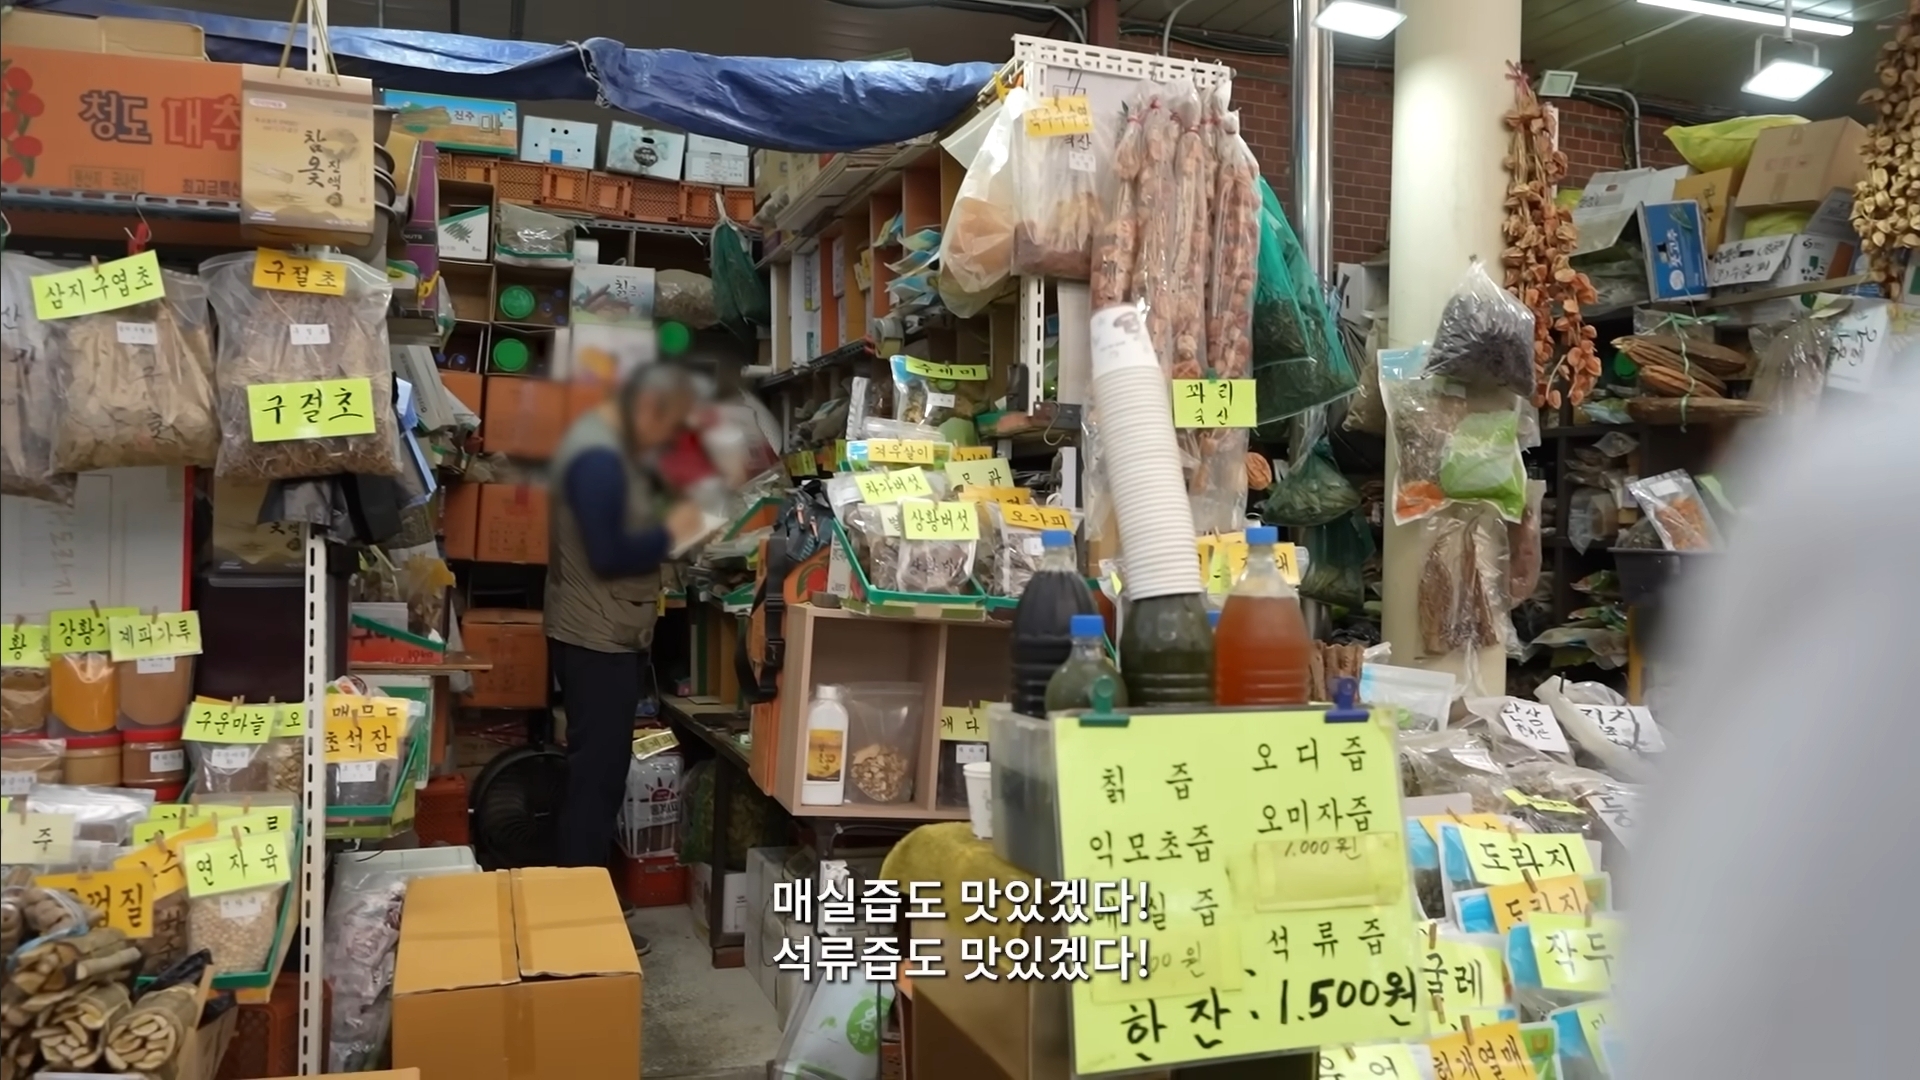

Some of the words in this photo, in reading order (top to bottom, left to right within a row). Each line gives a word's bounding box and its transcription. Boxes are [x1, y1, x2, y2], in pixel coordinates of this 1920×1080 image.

[79, 89, 153, 146] 청도
[44, 265, 154, 311] 삼지구엽초
[263, 259, 338, 290] 구절초
[914, 363, 977, 378] 수세미
[261, 387, 364, 425] 구절초
[1186, 380, 1234, 407] 꽈리
[865, 473, 924, 498] 차가버섯
[911, 508, 970, 533] 상황버섯
[1011, 510, 1069, 530] 오가피
[196, 711, 266, 736] 구운마늘
[325, 724, 392, 754] 초석잠
[1252, 735, 1367, 773] 오디즙
[1257, 796, 1374, 835] 오미자즙
[1089, 824, 1215, 867] 익모초즙
[1479, 842, 1577, 878] 도라지
[196, 843, 280, 887] 연자육
[1266, 918, 1386, 961] 석류즙
[1545, 929, 1615, 977] 작두
[1279, 965, 1418, 1026] 1.500원
